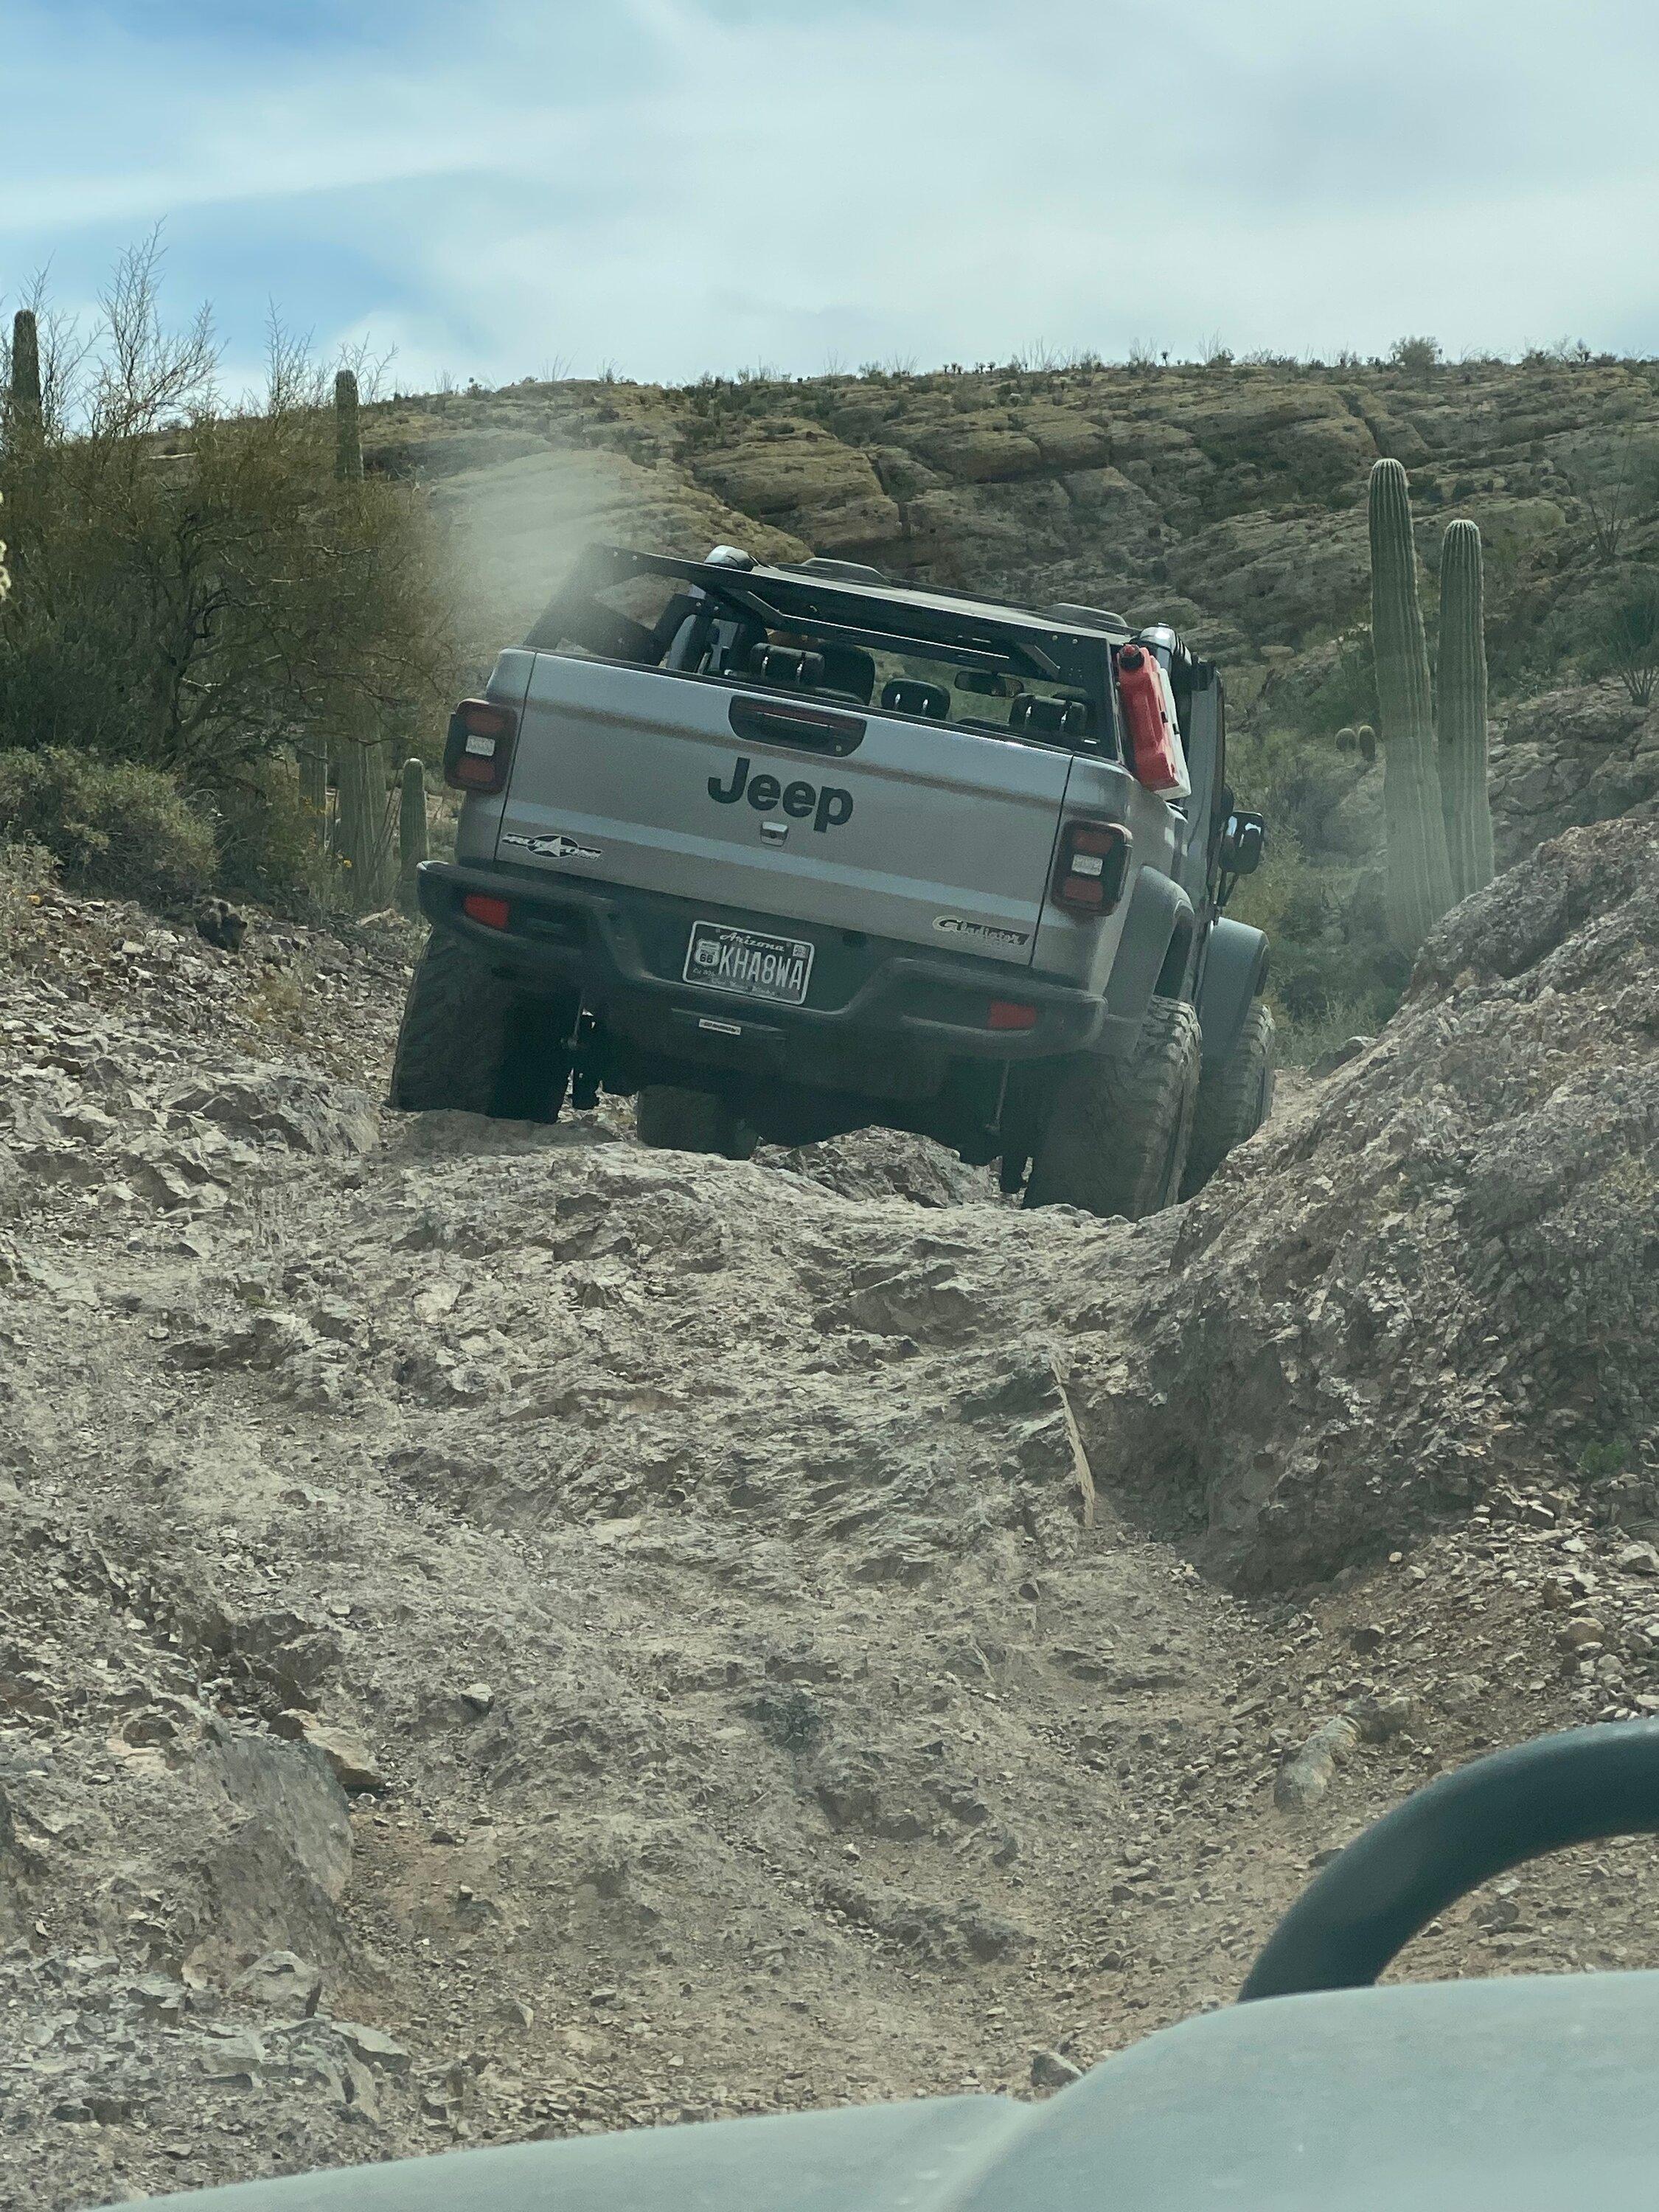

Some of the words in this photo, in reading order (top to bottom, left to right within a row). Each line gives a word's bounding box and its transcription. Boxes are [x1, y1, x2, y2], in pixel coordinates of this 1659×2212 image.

[708, 757, 853, 832] Jeep
[720, 932, 785, 951] Arizona
[718, 945, 803, 990] KHA8WA
